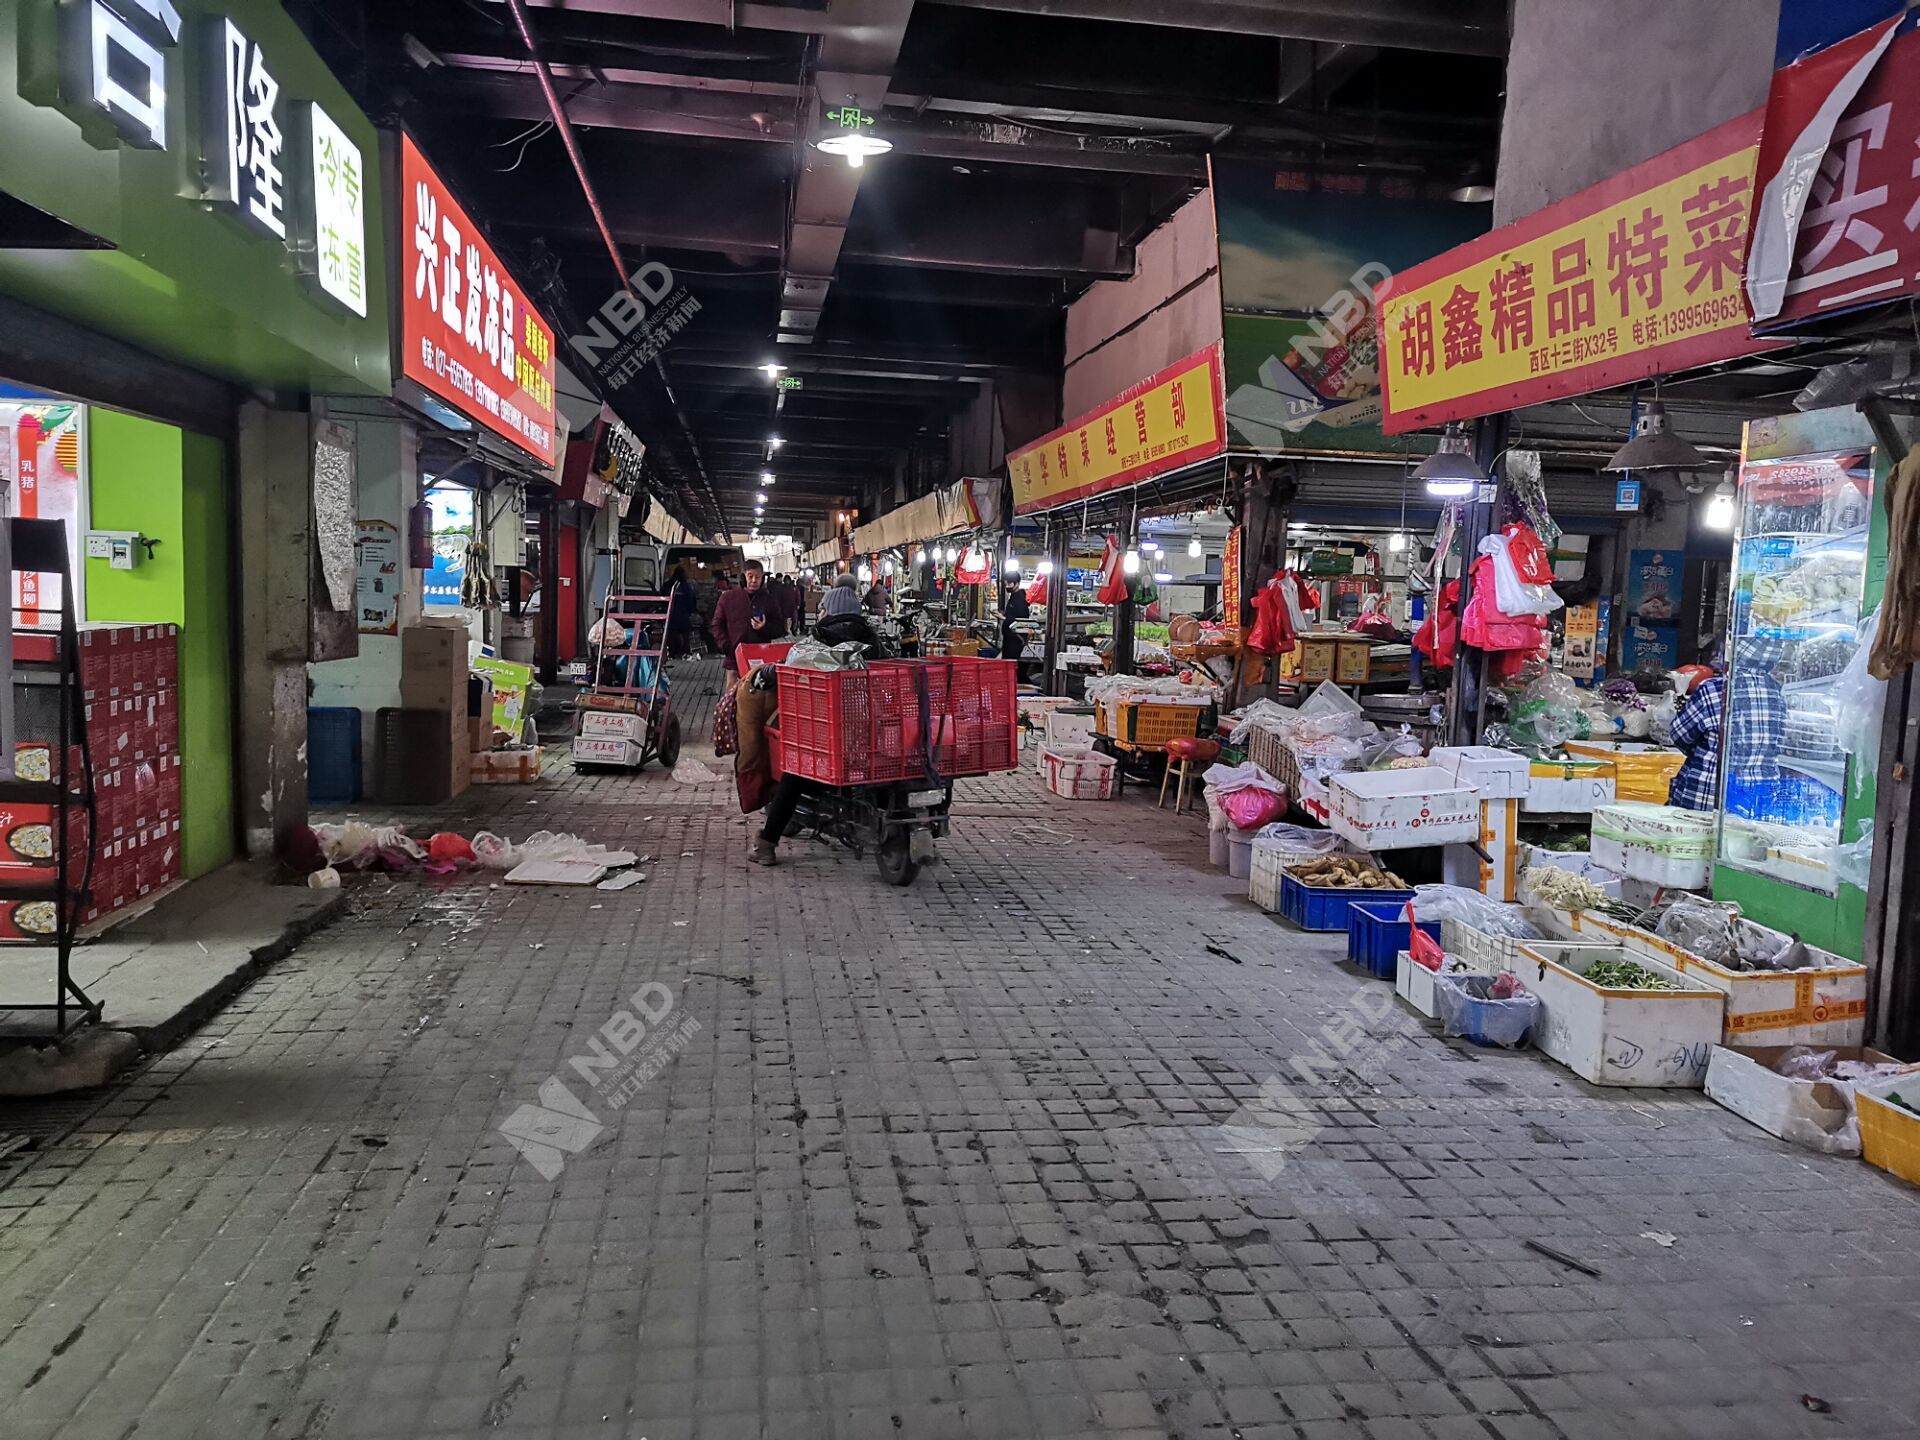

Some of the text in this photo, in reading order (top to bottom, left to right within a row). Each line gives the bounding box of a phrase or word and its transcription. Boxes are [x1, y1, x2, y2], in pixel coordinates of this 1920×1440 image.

[1399, 176, 1749, 378] 胡鑫精品特菜
[20, 459, 35, 489] 乳猪
